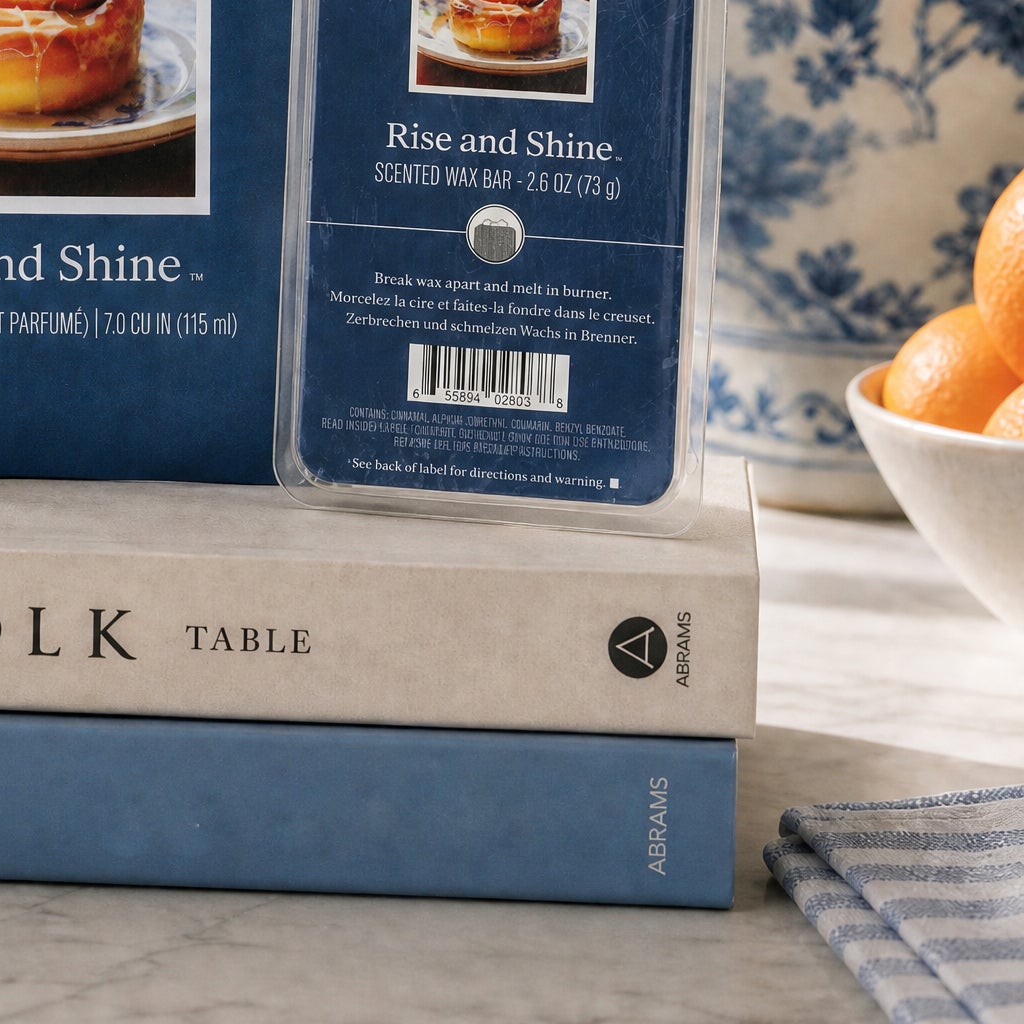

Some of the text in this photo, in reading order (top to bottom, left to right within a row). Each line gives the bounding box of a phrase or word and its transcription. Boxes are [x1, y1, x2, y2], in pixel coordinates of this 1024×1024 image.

[386, 122, 452, 151] Rise
[459, 128, 517, 155] and
[526, 130, 613, 162] Shine
[374, 162, 440, 186] SCENTED
[445, 166, 478, 188] WAX
[483, 169, 512, 190] BAR
[526, 171, 549, 192] 2.6
[554, 172, 572, 194] OZ
[577, 174, 601, 198] (73
[606, 177, 621, 201] g)
[59, 243, 181, 282] Shine
[374, 271, 612, 300] Break wax apart and melt in burner.
[9, 306, 90, 337] PARFUMÉ)
[104, 312, 126, 336] 7.0
[130, 312, 151, 336] CU
[155, 312, 172, 336] IN
[177, 311, 208, 338] (115
[212, 311, 238, 338] ml)
[329, 290, 656, 325] Morcelez la cire et faites-la fondre dans le creuset.
[346, 312, 638, 345] Zerbrechen und schmelzen Wachs in Brenner.
[349, 406, 389, 420] CONTAINS:
[412, 388, 420, 399] 6
[444, 390, 481, 404] 55894
[556, 398, 564, 409] 8
[321, 417, 343, 429] READ
[375, 459, 402, 472] back
[405, 462, 418, 473] of
[419, 463, 447, 476] label
[450, 465, 467, 477] for
[470, 467, 528, 481] directions
[530, 472, 552, 483] and
[555, 476, 606, 490] warning.
[186, 624, 312, 654] TABLE
[676, 611, 692, 688] ABRAMS
[648, 777, 668, 875] ABRAMS
